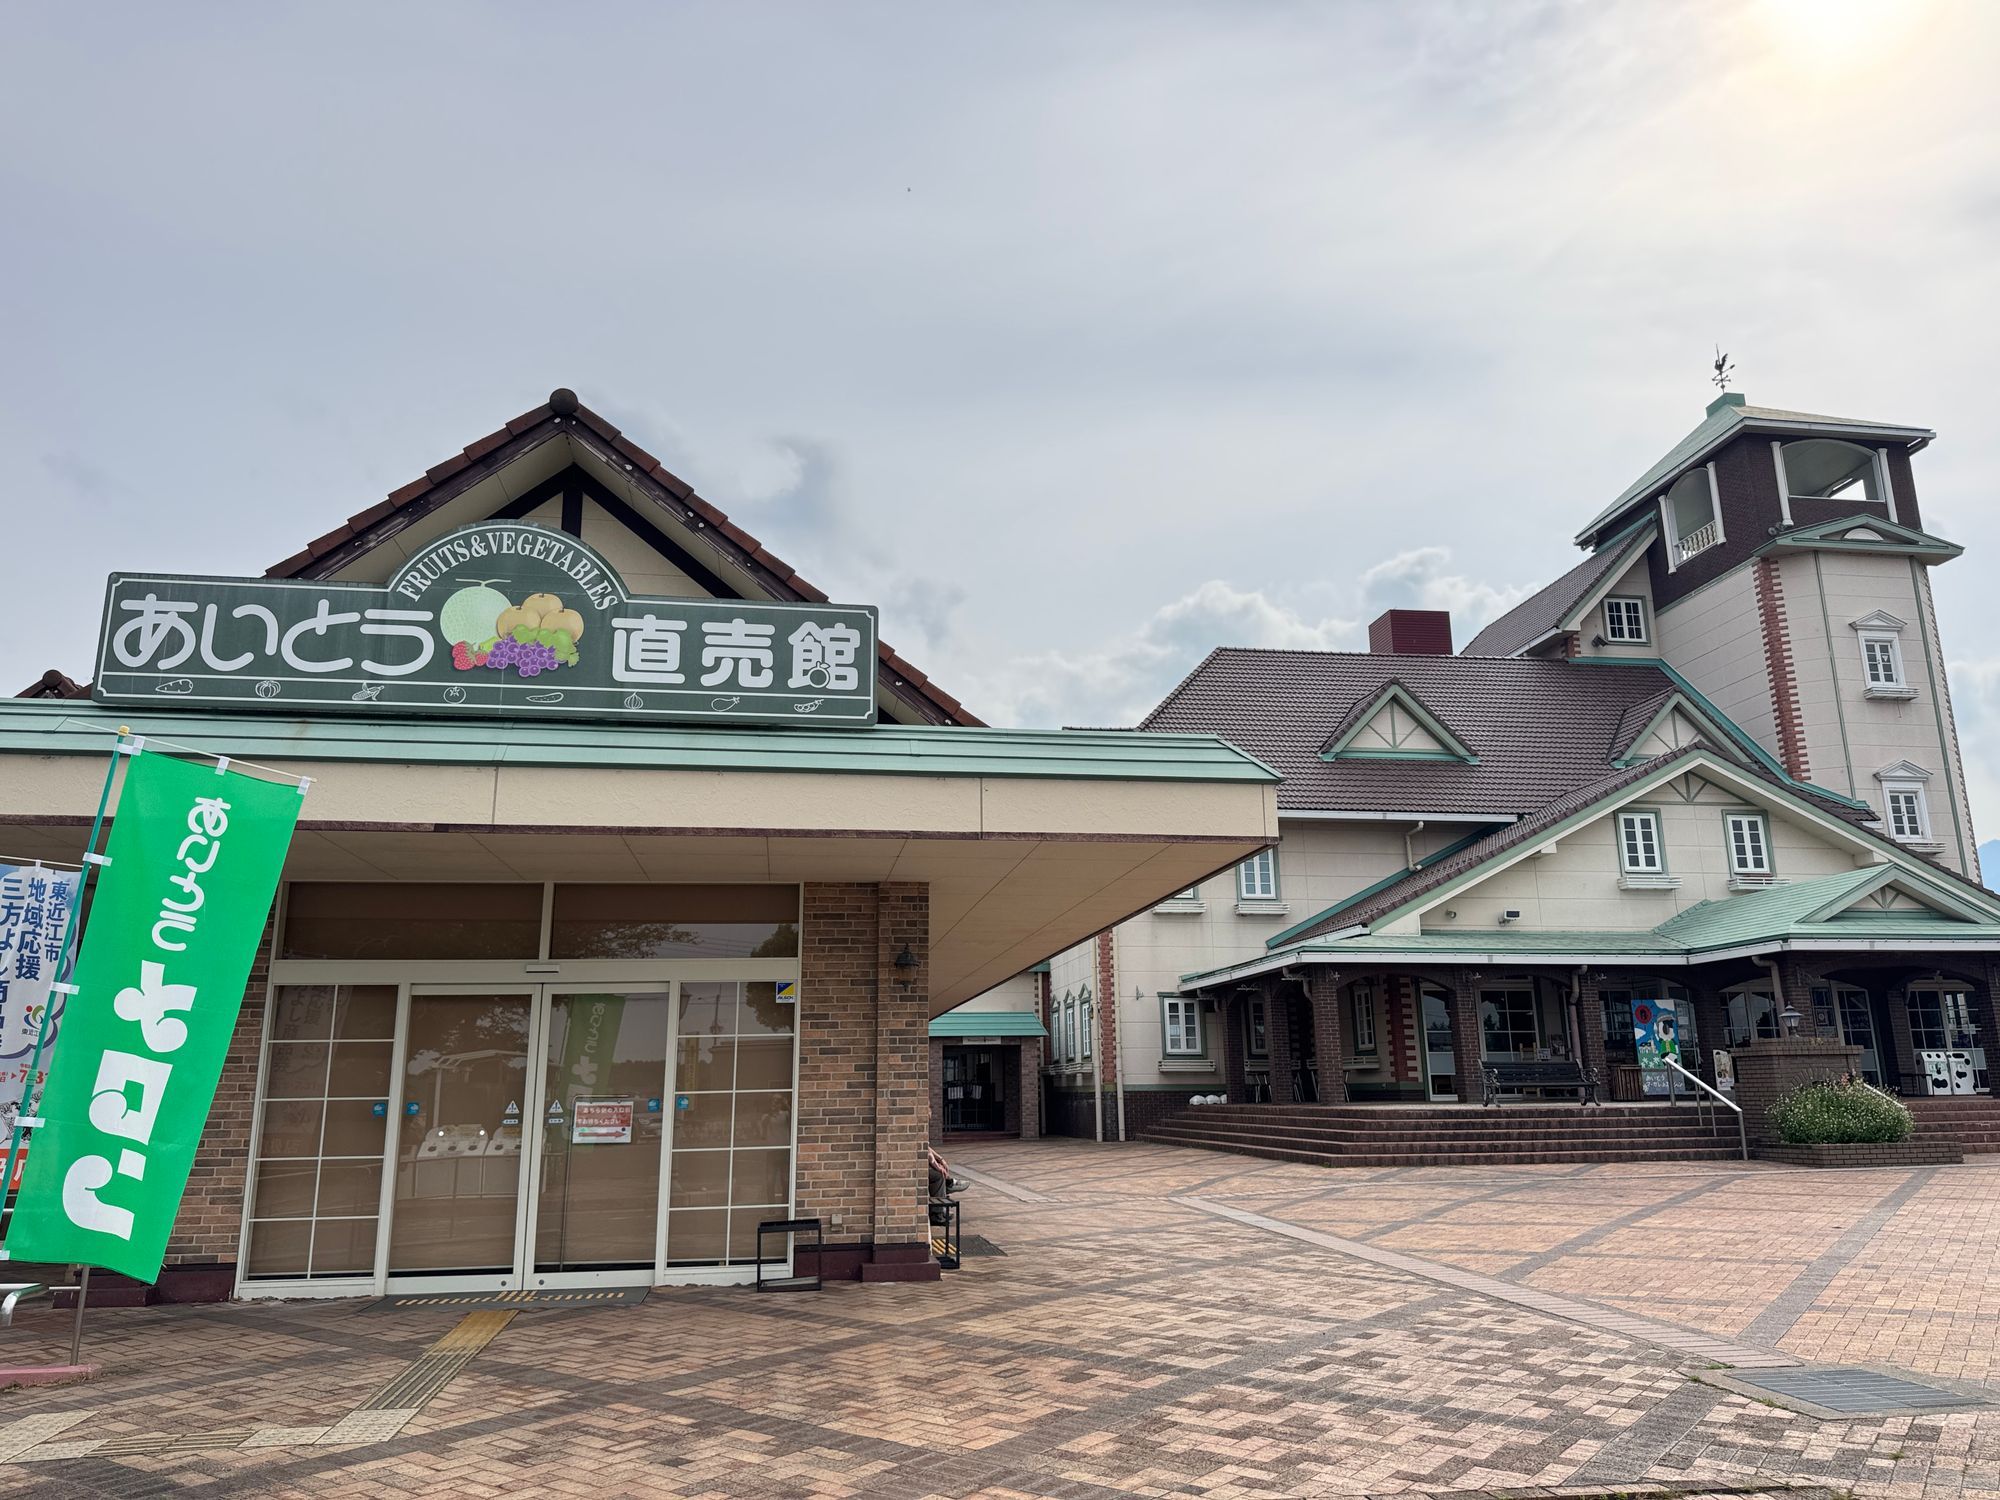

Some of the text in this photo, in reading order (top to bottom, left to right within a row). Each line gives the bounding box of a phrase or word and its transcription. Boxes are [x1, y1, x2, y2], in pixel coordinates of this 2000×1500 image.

[397, 531, 618, 611] FRUITS&VEGETABLES
[112, 592, 861, 693] あいとう 直売館
[15, 877, 47, 982] 地域応援
[44, 880, 70, 963] 東近江市
